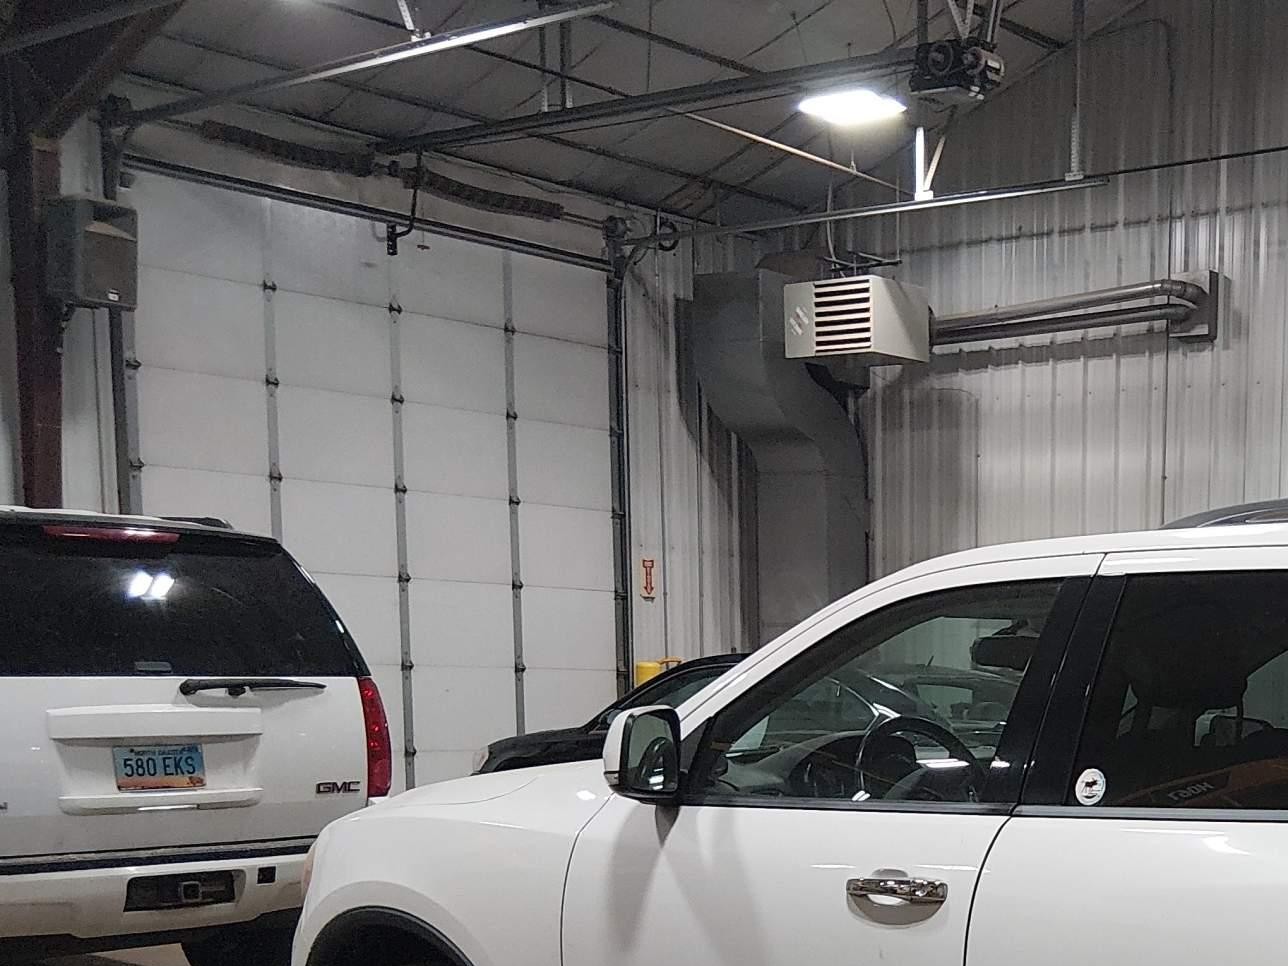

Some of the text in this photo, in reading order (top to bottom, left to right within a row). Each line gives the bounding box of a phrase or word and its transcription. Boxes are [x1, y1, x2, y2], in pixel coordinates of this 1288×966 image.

[123, 756, 196, 777] 580 EKS
[315, 781, 361, 794] GMC
